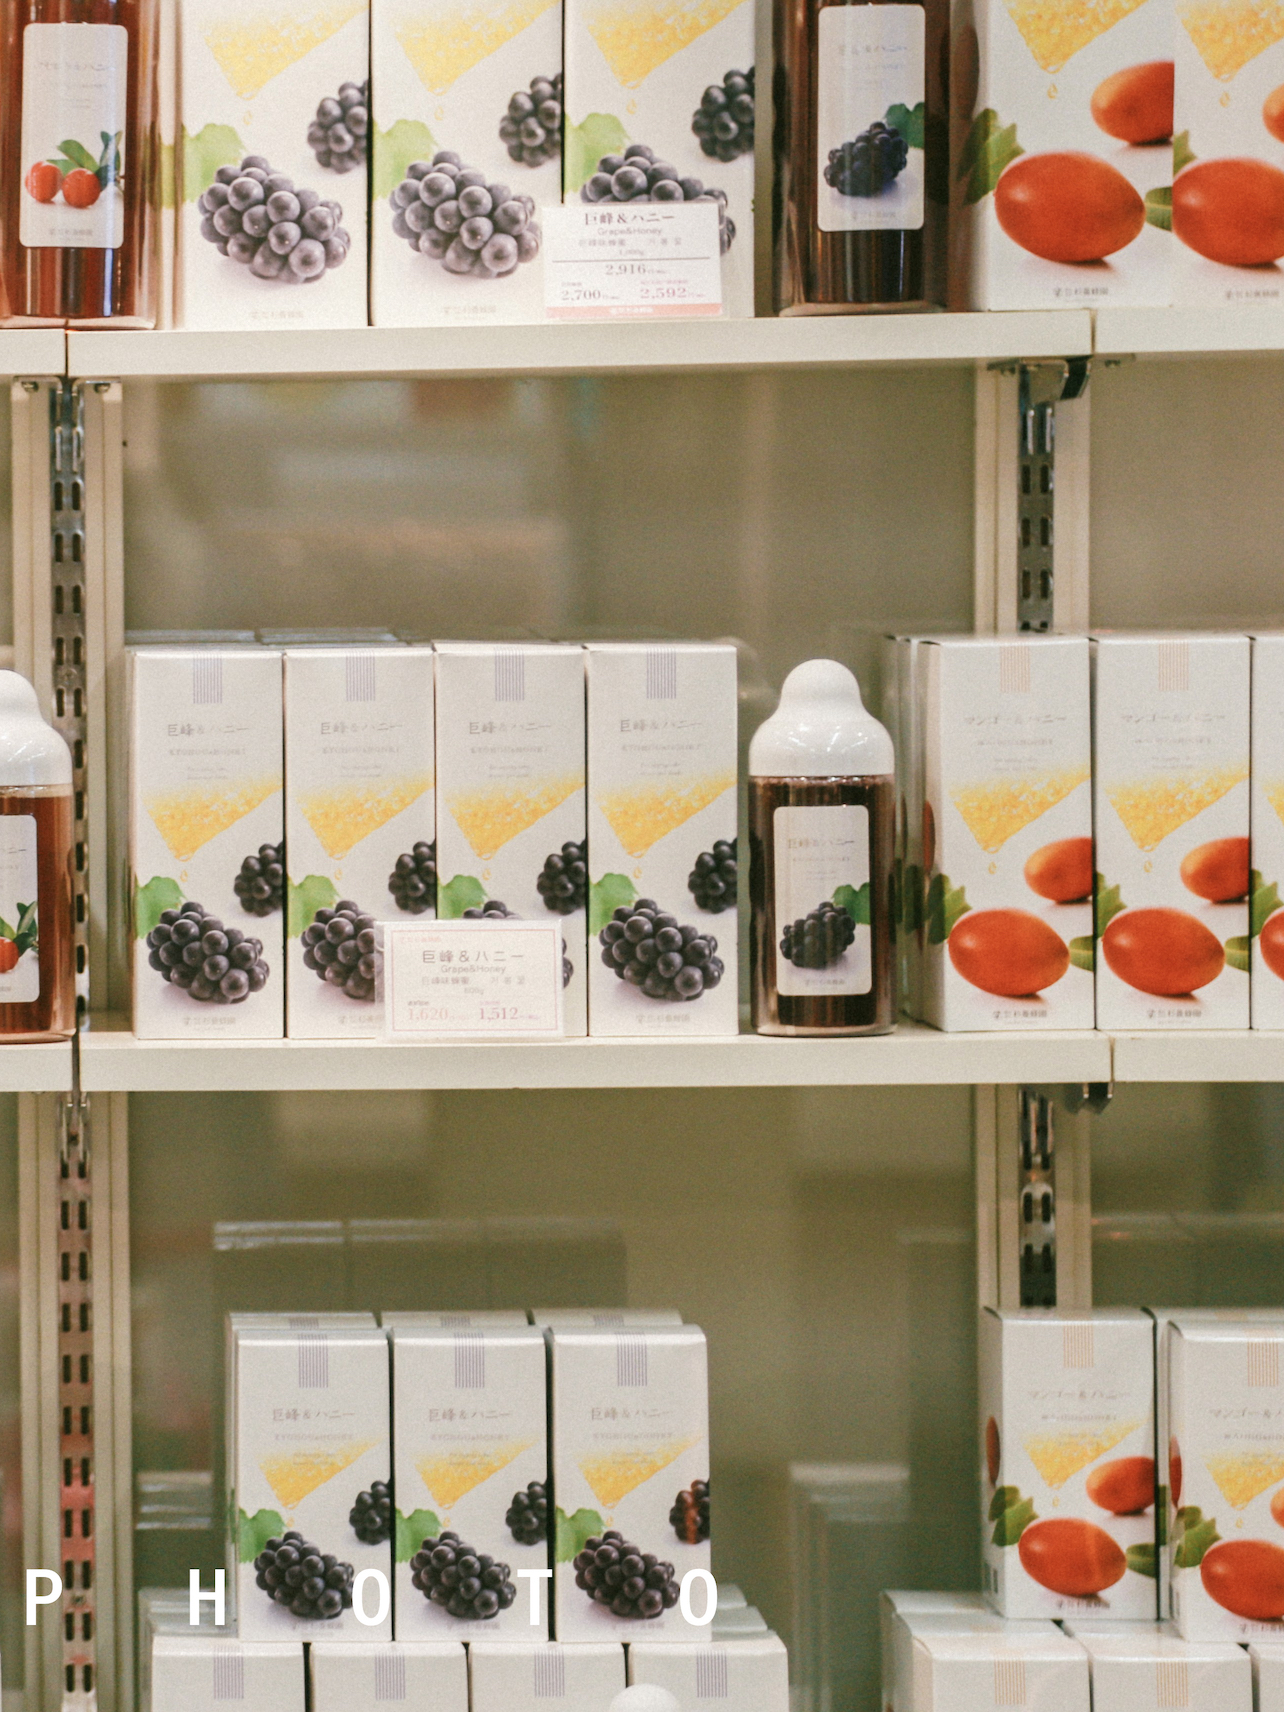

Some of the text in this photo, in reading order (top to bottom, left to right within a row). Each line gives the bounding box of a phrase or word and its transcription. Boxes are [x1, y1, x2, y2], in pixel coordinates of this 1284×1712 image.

[422, 950, 525, 963] 巨峰&ハニー
[407, 1006, 519, 1022] 1,620 1,512
